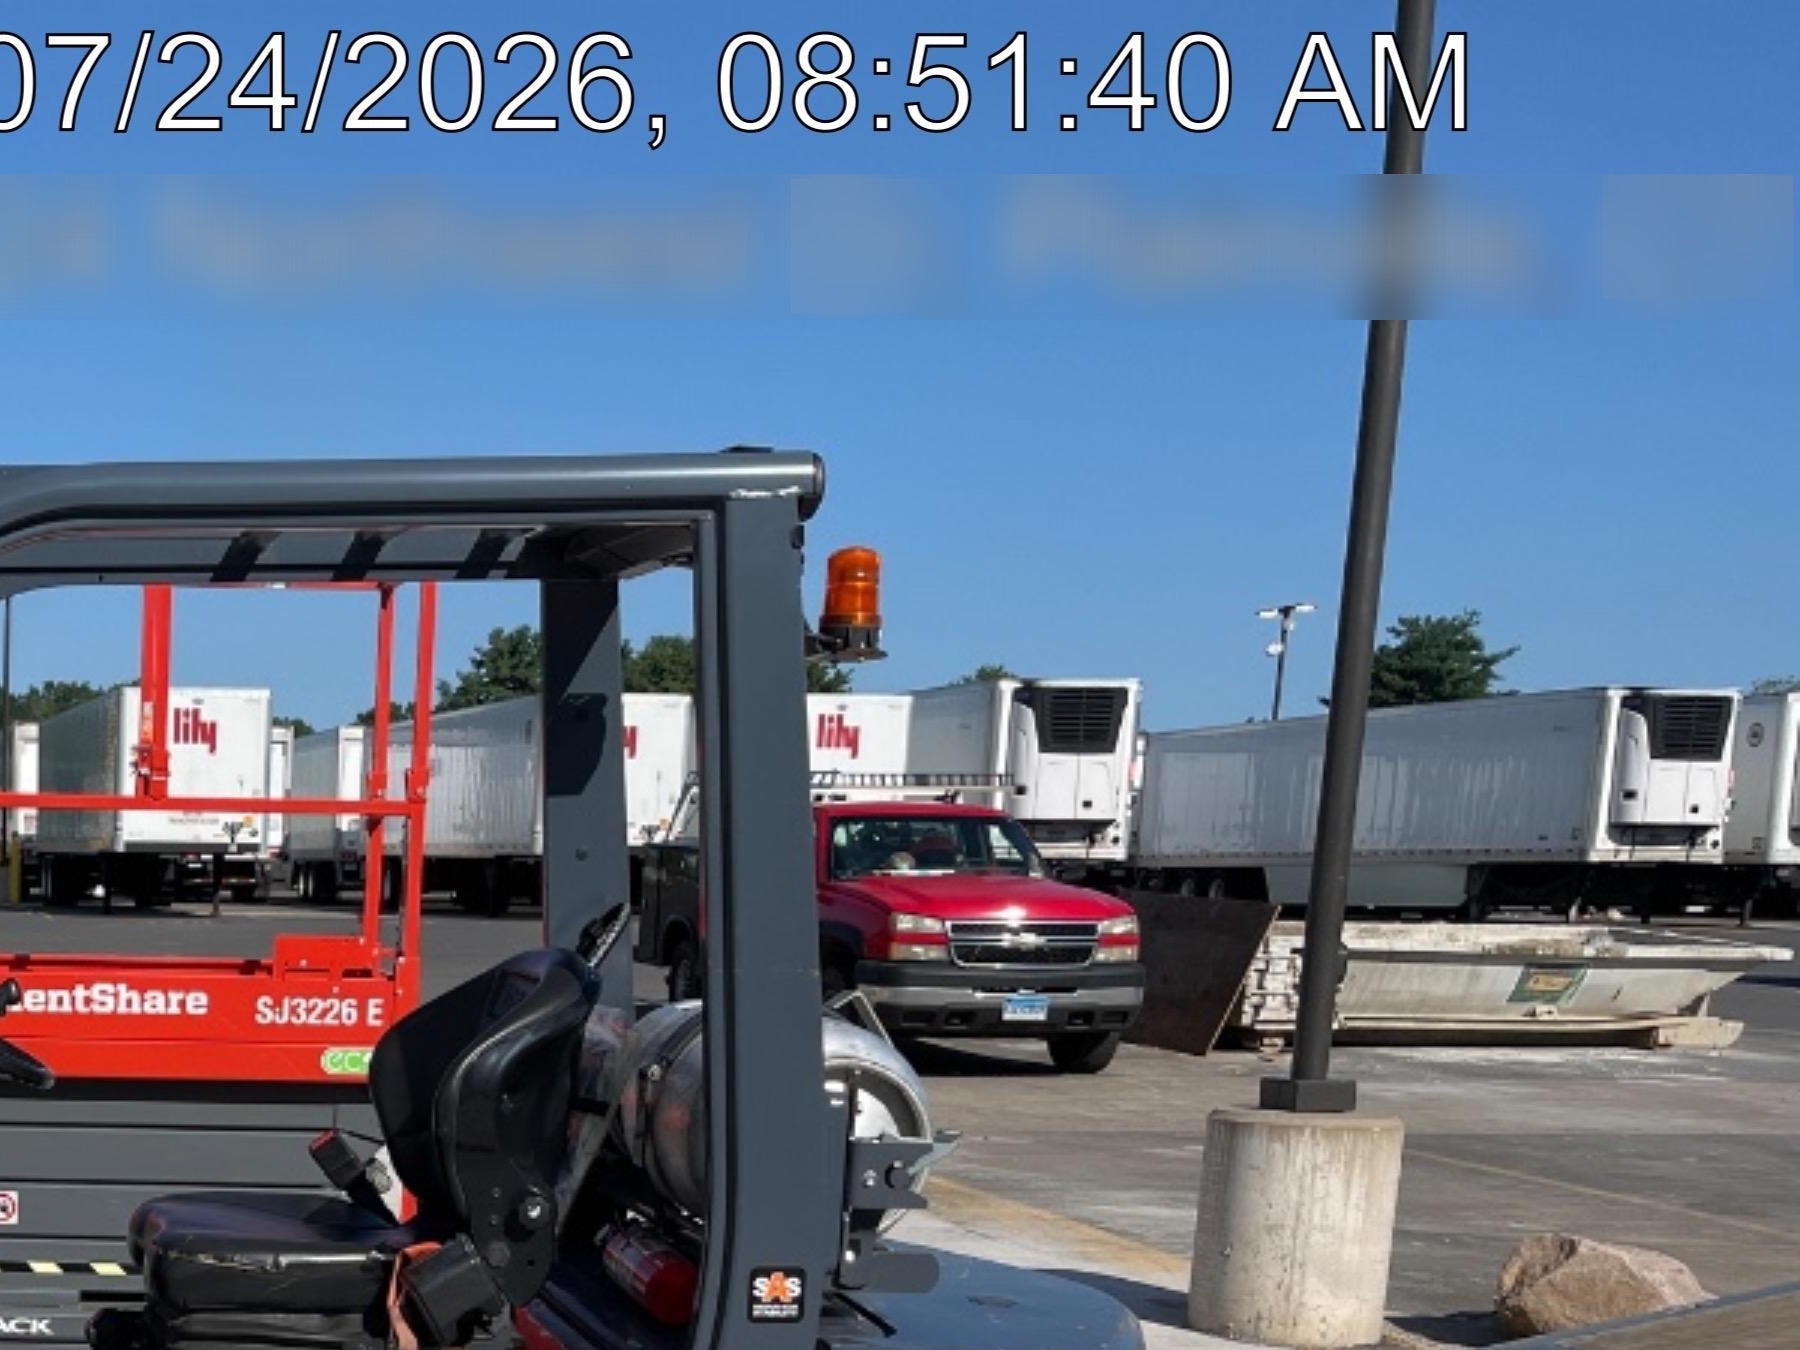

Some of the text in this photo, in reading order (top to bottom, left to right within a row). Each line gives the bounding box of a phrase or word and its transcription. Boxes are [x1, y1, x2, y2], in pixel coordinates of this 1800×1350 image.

[173, 707, 217, 754] lily
[816, 713, 860, 759] lily
[255, 995, 384, 1027] SJ3226 E
[752, 1271, 802, 1303] SAS
